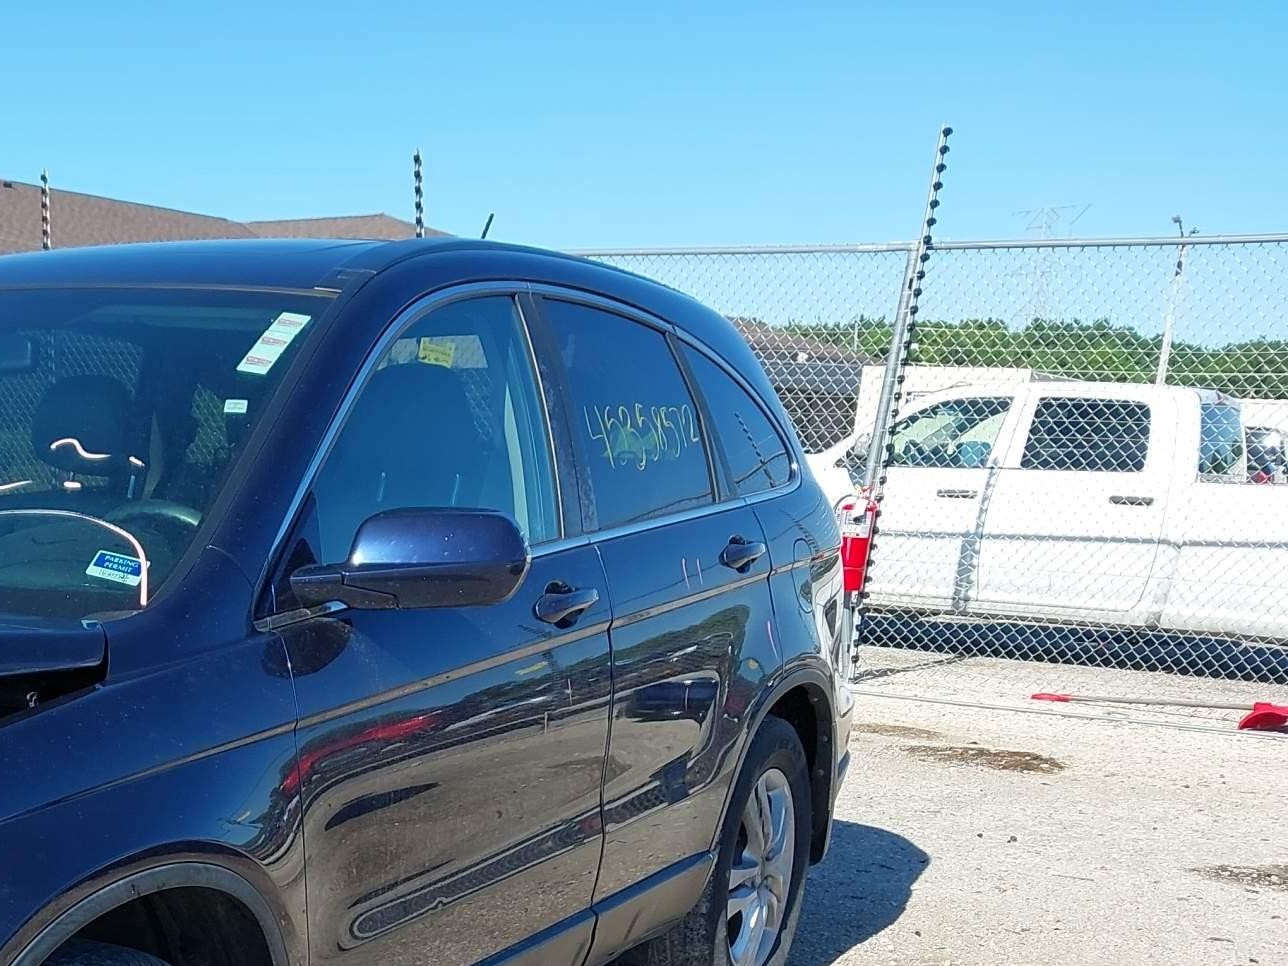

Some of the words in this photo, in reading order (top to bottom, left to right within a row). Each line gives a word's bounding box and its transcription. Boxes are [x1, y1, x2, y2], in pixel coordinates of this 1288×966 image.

[583, 403, 699, 470] 45358572
[103, 561, 133, 573] PERMIT
[104, 555, 139, 568] PARKING
